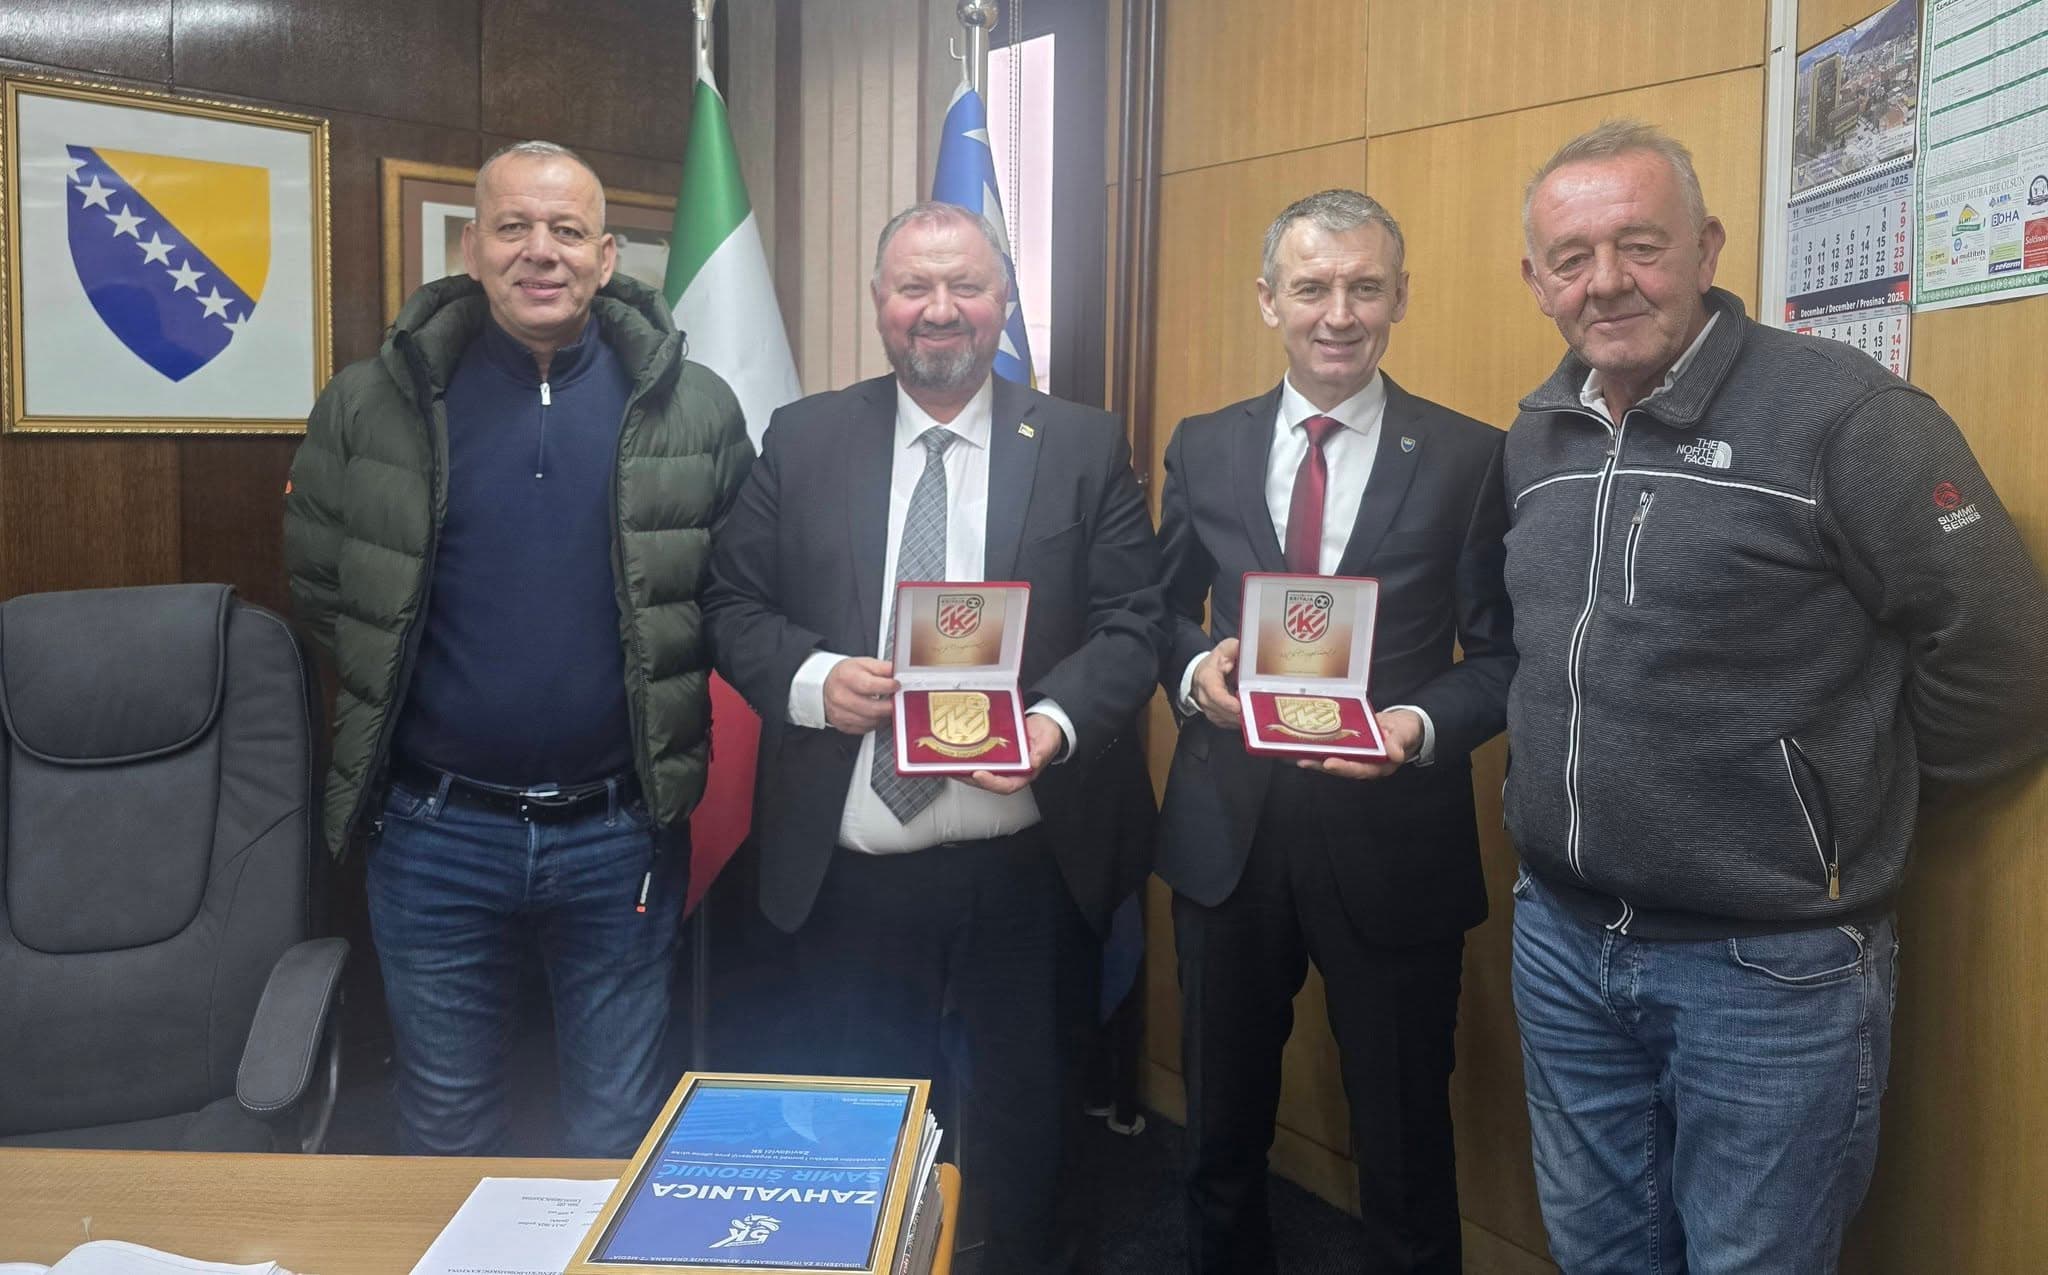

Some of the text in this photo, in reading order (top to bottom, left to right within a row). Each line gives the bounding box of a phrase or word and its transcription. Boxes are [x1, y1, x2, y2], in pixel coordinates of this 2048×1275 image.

[1793, 209, 1799, 219] 11
[1835, 191, 1863, 206] November
[1866, 181, 1889, 195] Studeni
[1891, 174, 1909, 188] 2025
[1882, 206, 1887, 218] 1
[1900, 201, 1906, 213] 2
[1808, 241, 1812, 252] 3
[1821, 237, 1826, 248] 4
[1835, 234, 1840, 245] 5
[1850, 229, 1855, 241] 6
[1866, 225, 1870, 236] 7
[1881, 221, 1886, 232] 8
[1900, 216, 1905, 228] 9
[1804, 255, 1812, 266] 10
[1817, 251, 1825, 262] 11
[1832, 248, 1840, 259] 12
[1846, 244, 1854, 256] 13
[1861, 240, 1870, 252] 14
[1877, 236, 1886, 248] 15
[1895, 232, 1905, 243] 16
[1804, 268, 1811, 279] 17
[1817, 265, 1825, 276] 18
[1831, 261, 1839, 272] 19
[1845, 258, 1853, 270] 20
[1860, 255, 1868, 266] 21
[1876, 250, 1885, 262] 22
[1894, 246, 1904, 258] 23
[1802, 281, 1810, 292] 24
[1816, 278, 1824, 289] 25
[1829, 275, 1838, 286] 26
[1844, 272, 1853, 283] 27
[1859, 268, 1868, 280] 28
[1875, 265, 1885, 277] 29
[1893, 261, 1904, 273] 30
[1789, 310, 1795, 320] 12
[1829, 301, 1856, 314] December
[1860, 296, 1885, 308] Prosinac
[1887, 291, 1904, 303] 2025
[1832, 328, 1836, 339] 3
[1847, 326, 1851, 336] 4
[1862, 324, 1867, 335] 5
[1878, 321, 1883, 333] 6
[1896, 319, 1901, 331] 7
[1858, 334, 1901, 349] 12 13 14
[1890, 349, 1900, 360] 21
[1890, 363, 1899, 374] 28
[1676, 444, 1716, 459] NORTH
[1696, 438, 1719, 450] THE
[1683, 454, 1713, 467] FACE
[1938, 503, 1977, 525] SUMMIT
[1942, 511, 1981, 533] SERIES
[656, 1164, 883, 1184] SAMIR ŠIBONJIĆ
[651, 1183, 878, 1204] ZAHVALNICA
